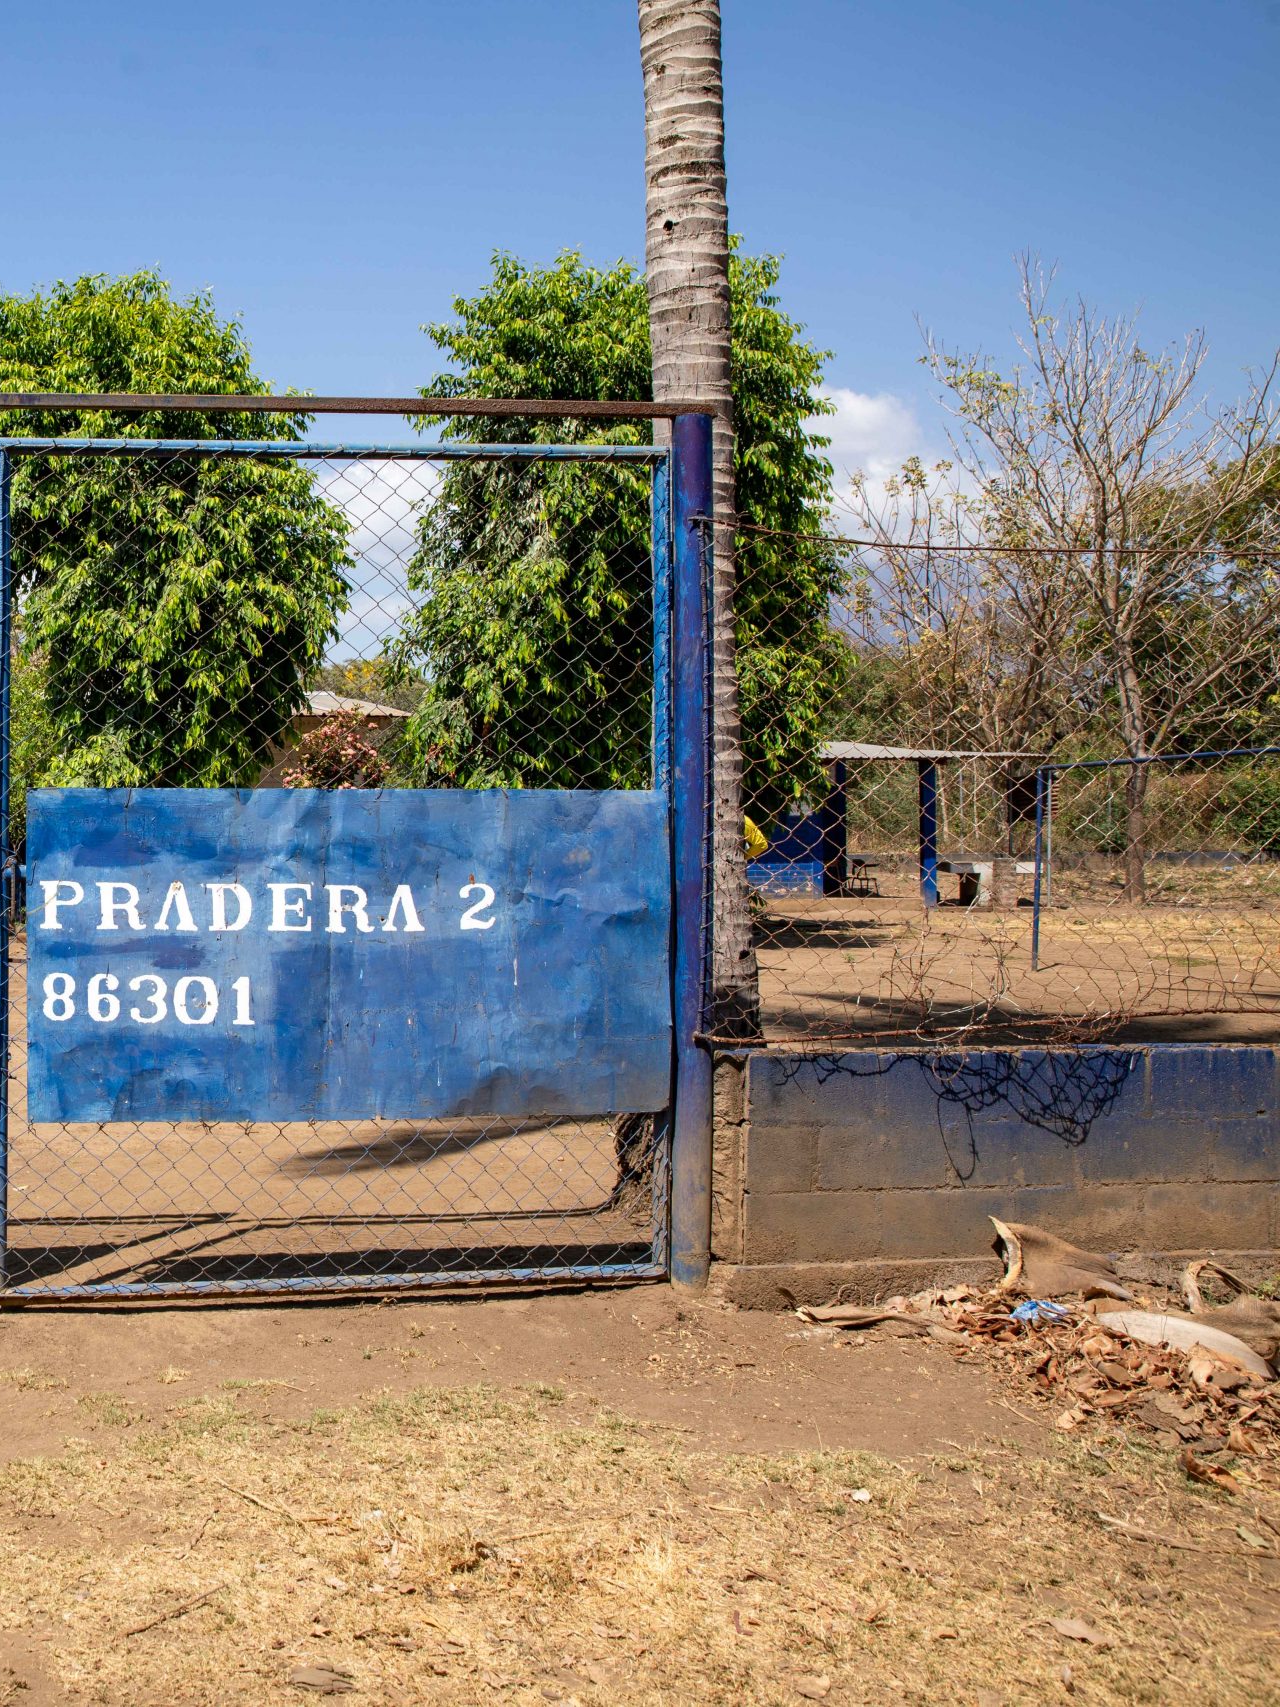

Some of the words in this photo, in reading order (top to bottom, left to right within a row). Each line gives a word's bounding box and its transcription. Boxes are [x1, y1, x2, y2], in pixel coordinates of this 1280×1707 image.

[39, 879, 427, 934] PRADERA
[458, 882, 497, 931] 2
[42, 972, 257, 1026] 86301
